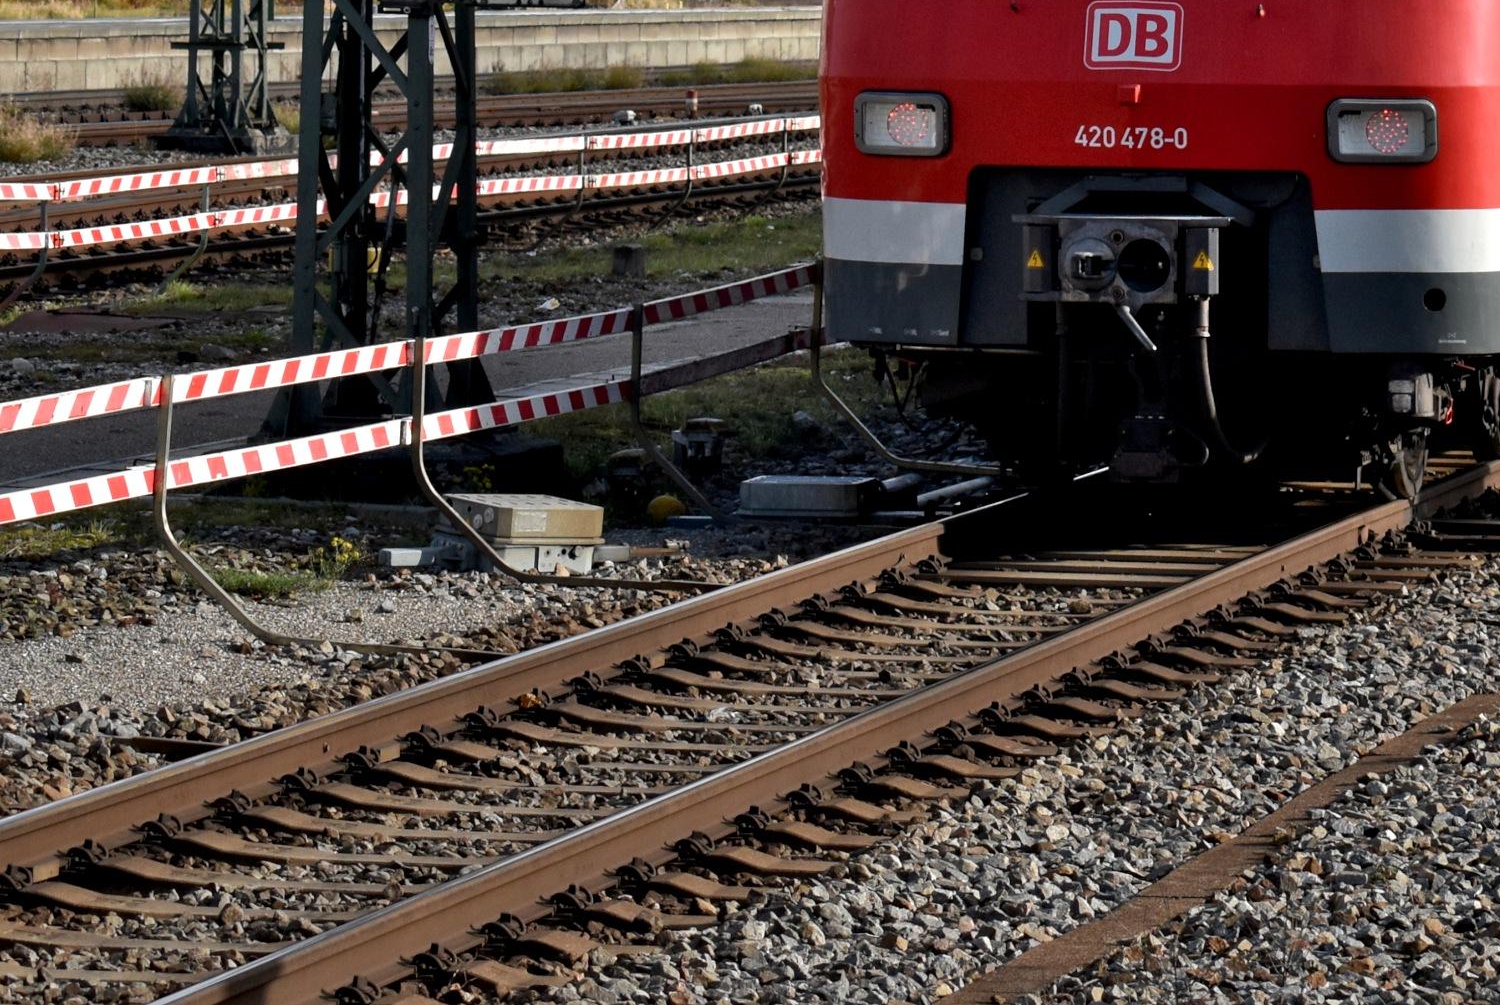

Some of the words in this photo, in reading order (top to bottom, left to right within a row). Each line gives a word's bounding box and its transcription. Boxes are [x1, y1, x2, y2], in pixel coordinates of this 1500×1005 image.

[1098, 13, 1169, 58] DB
[1074, 125, 1116, 148] 420
[1121, 127, 1188, 149] 478-0
